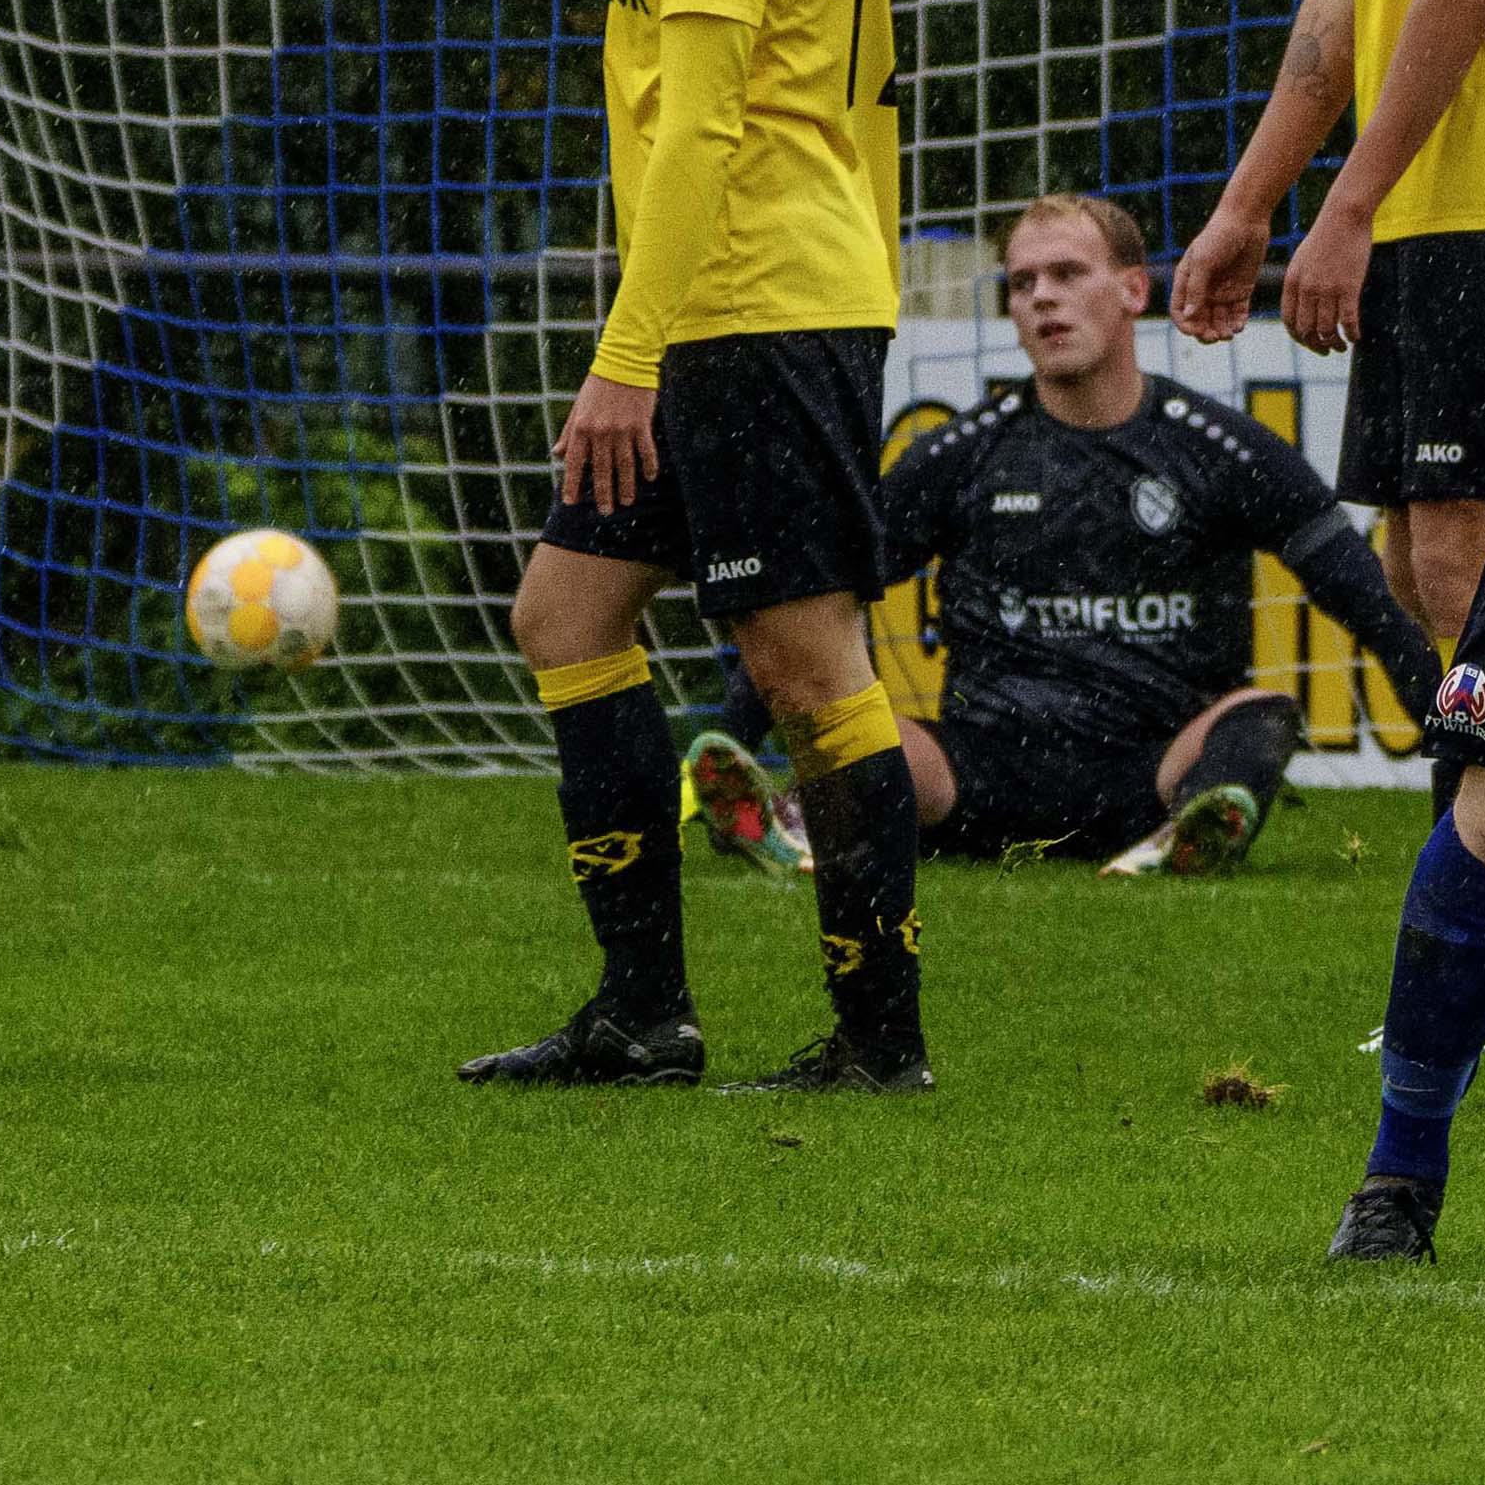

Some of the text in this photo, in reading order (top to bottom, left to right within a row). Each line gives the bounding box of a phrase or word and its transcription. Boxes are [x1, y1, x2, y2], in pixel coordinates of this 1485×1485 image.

[1415, 444, 1463, 464] JAKO
[990, 494, 1040, 514] JAKO
[706, 557, 762, 584] JAKO
[1026, 592, 1194, 632] TRIFLOR
